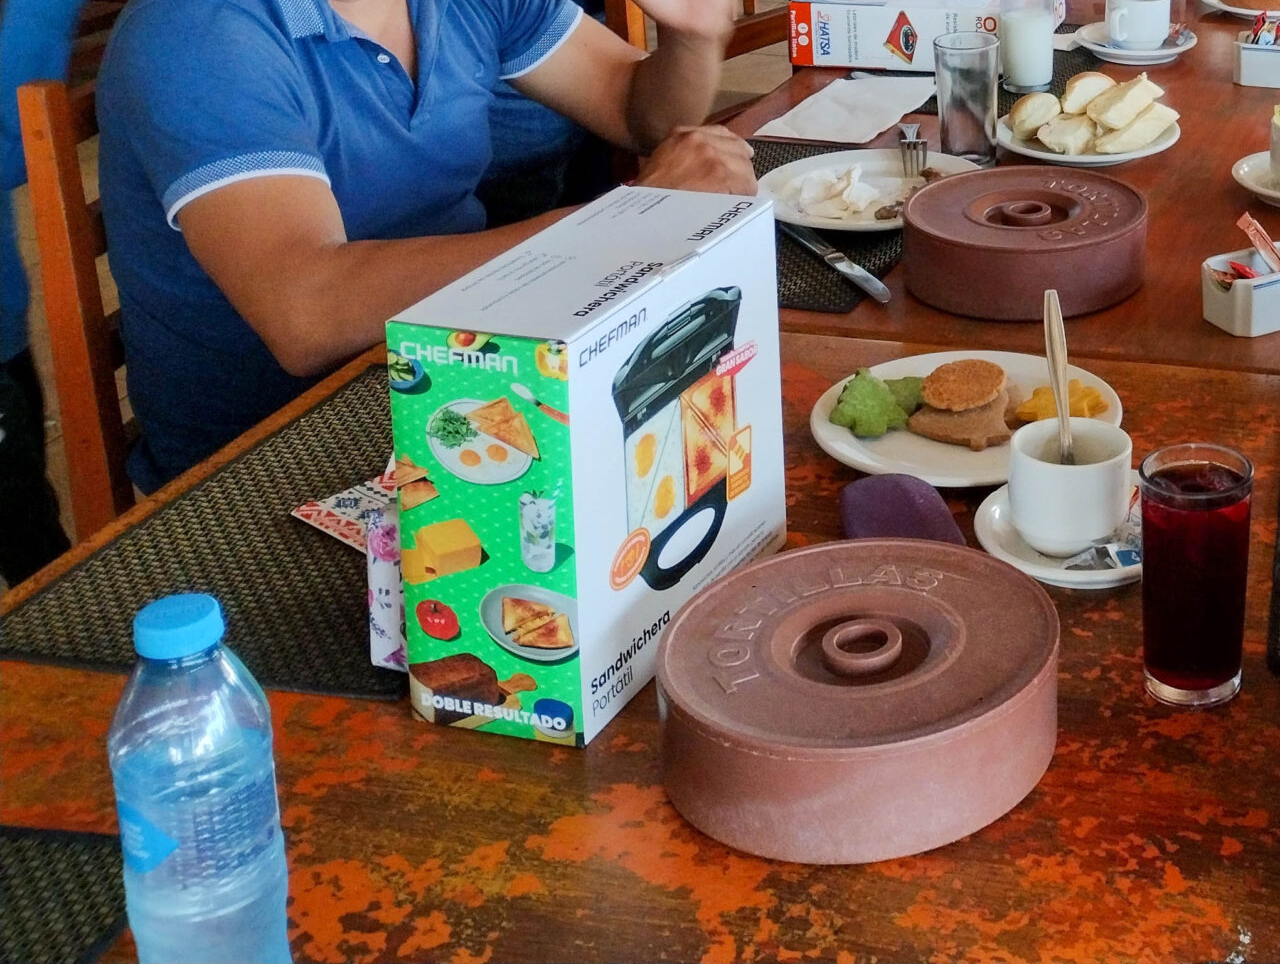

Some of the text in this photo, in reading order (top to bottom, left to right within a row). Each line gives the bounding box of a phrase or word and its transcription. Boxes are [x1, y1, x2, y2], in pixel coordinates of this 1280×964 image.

[820, 21, 831, 56] HATSA
[687, 201, 753, 242] CHEFMAN
[573, 261, 664, 317] Sandwichera
[399, 341, 518, 376] CHEFMAN
[578, 307, 647, 368] CHEFMAN
[590, 609, 671, 695] Sandwichera
[420, 692, 567, 732] DOBLE RESULTADO
[591, 668, 634, 718] Portátil
